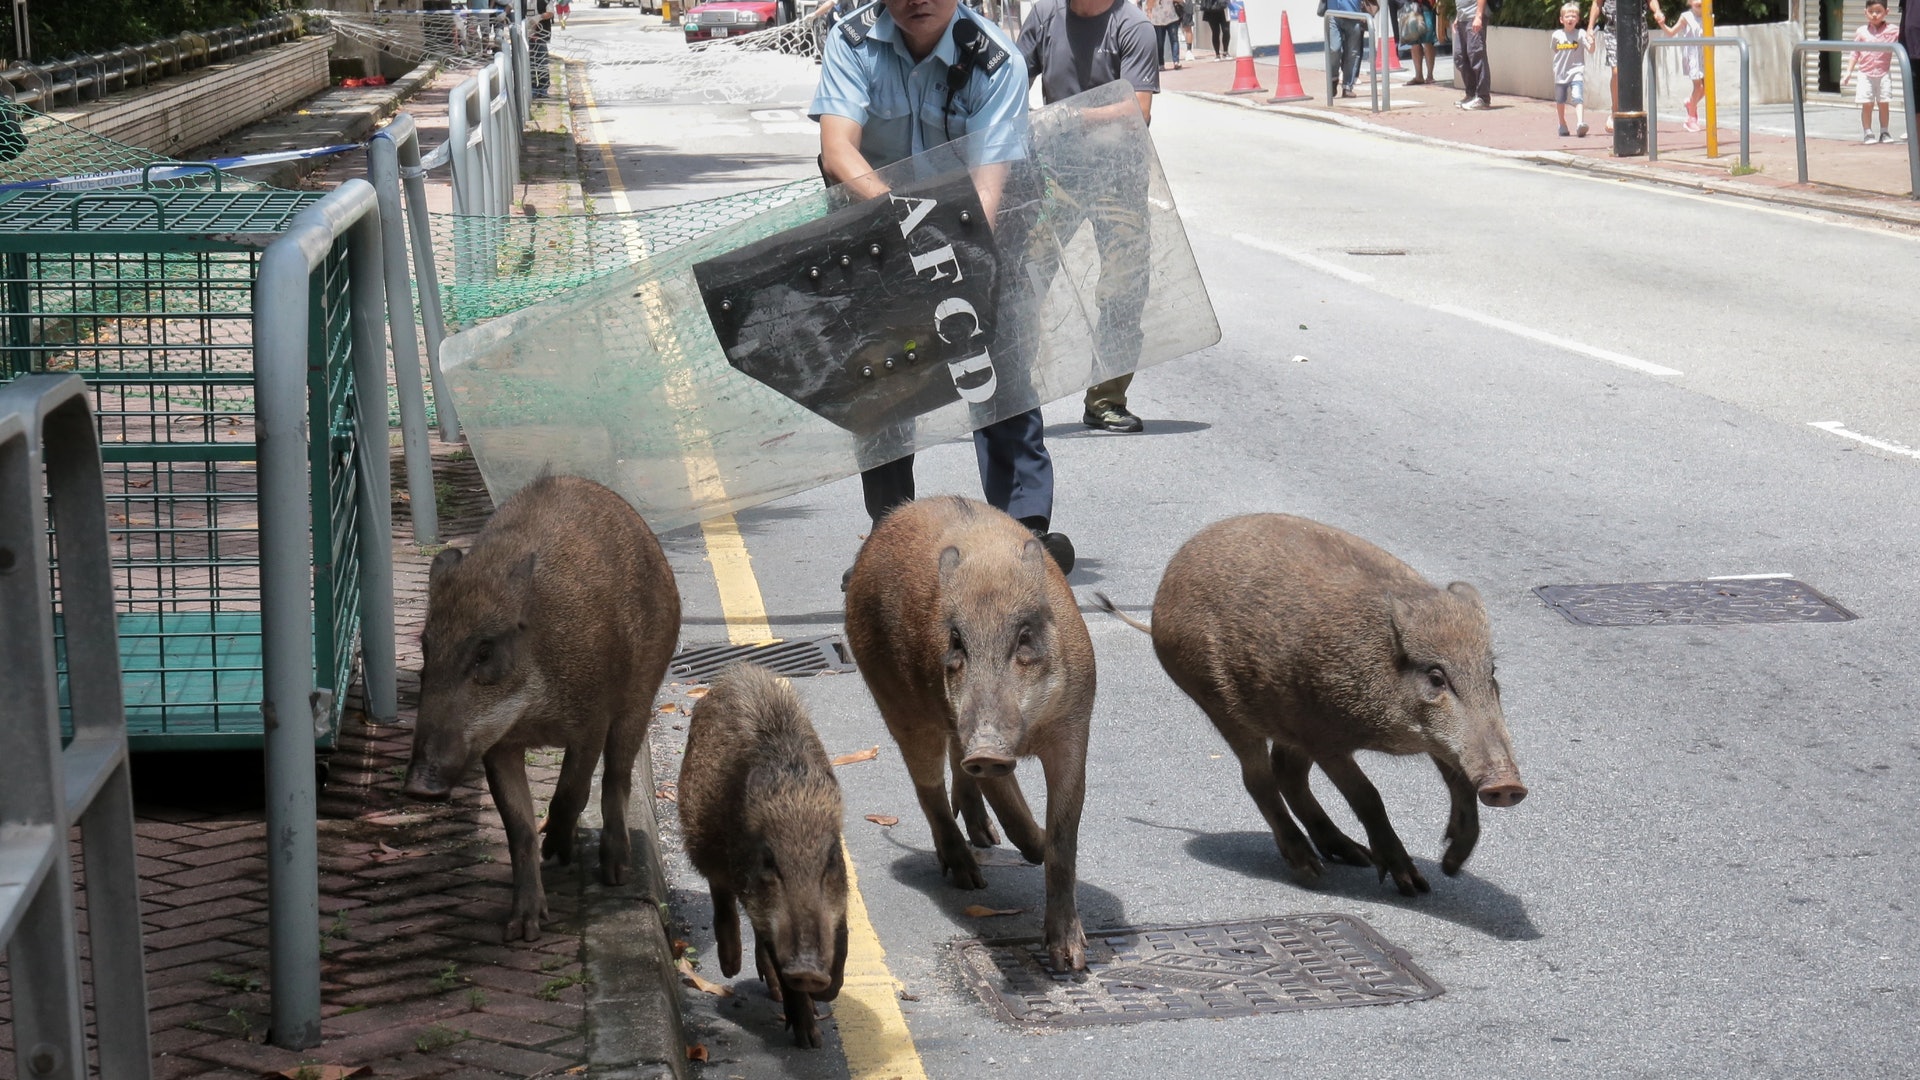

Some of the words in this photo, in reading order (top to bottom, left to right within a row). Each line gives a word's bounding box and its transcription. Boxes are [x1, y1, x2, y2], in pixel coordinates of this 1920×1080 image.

[843, 24, 861, 41] 48860
[986, 50, 1005, 70] 48860
[888, 192, 998, 404] AFCD
